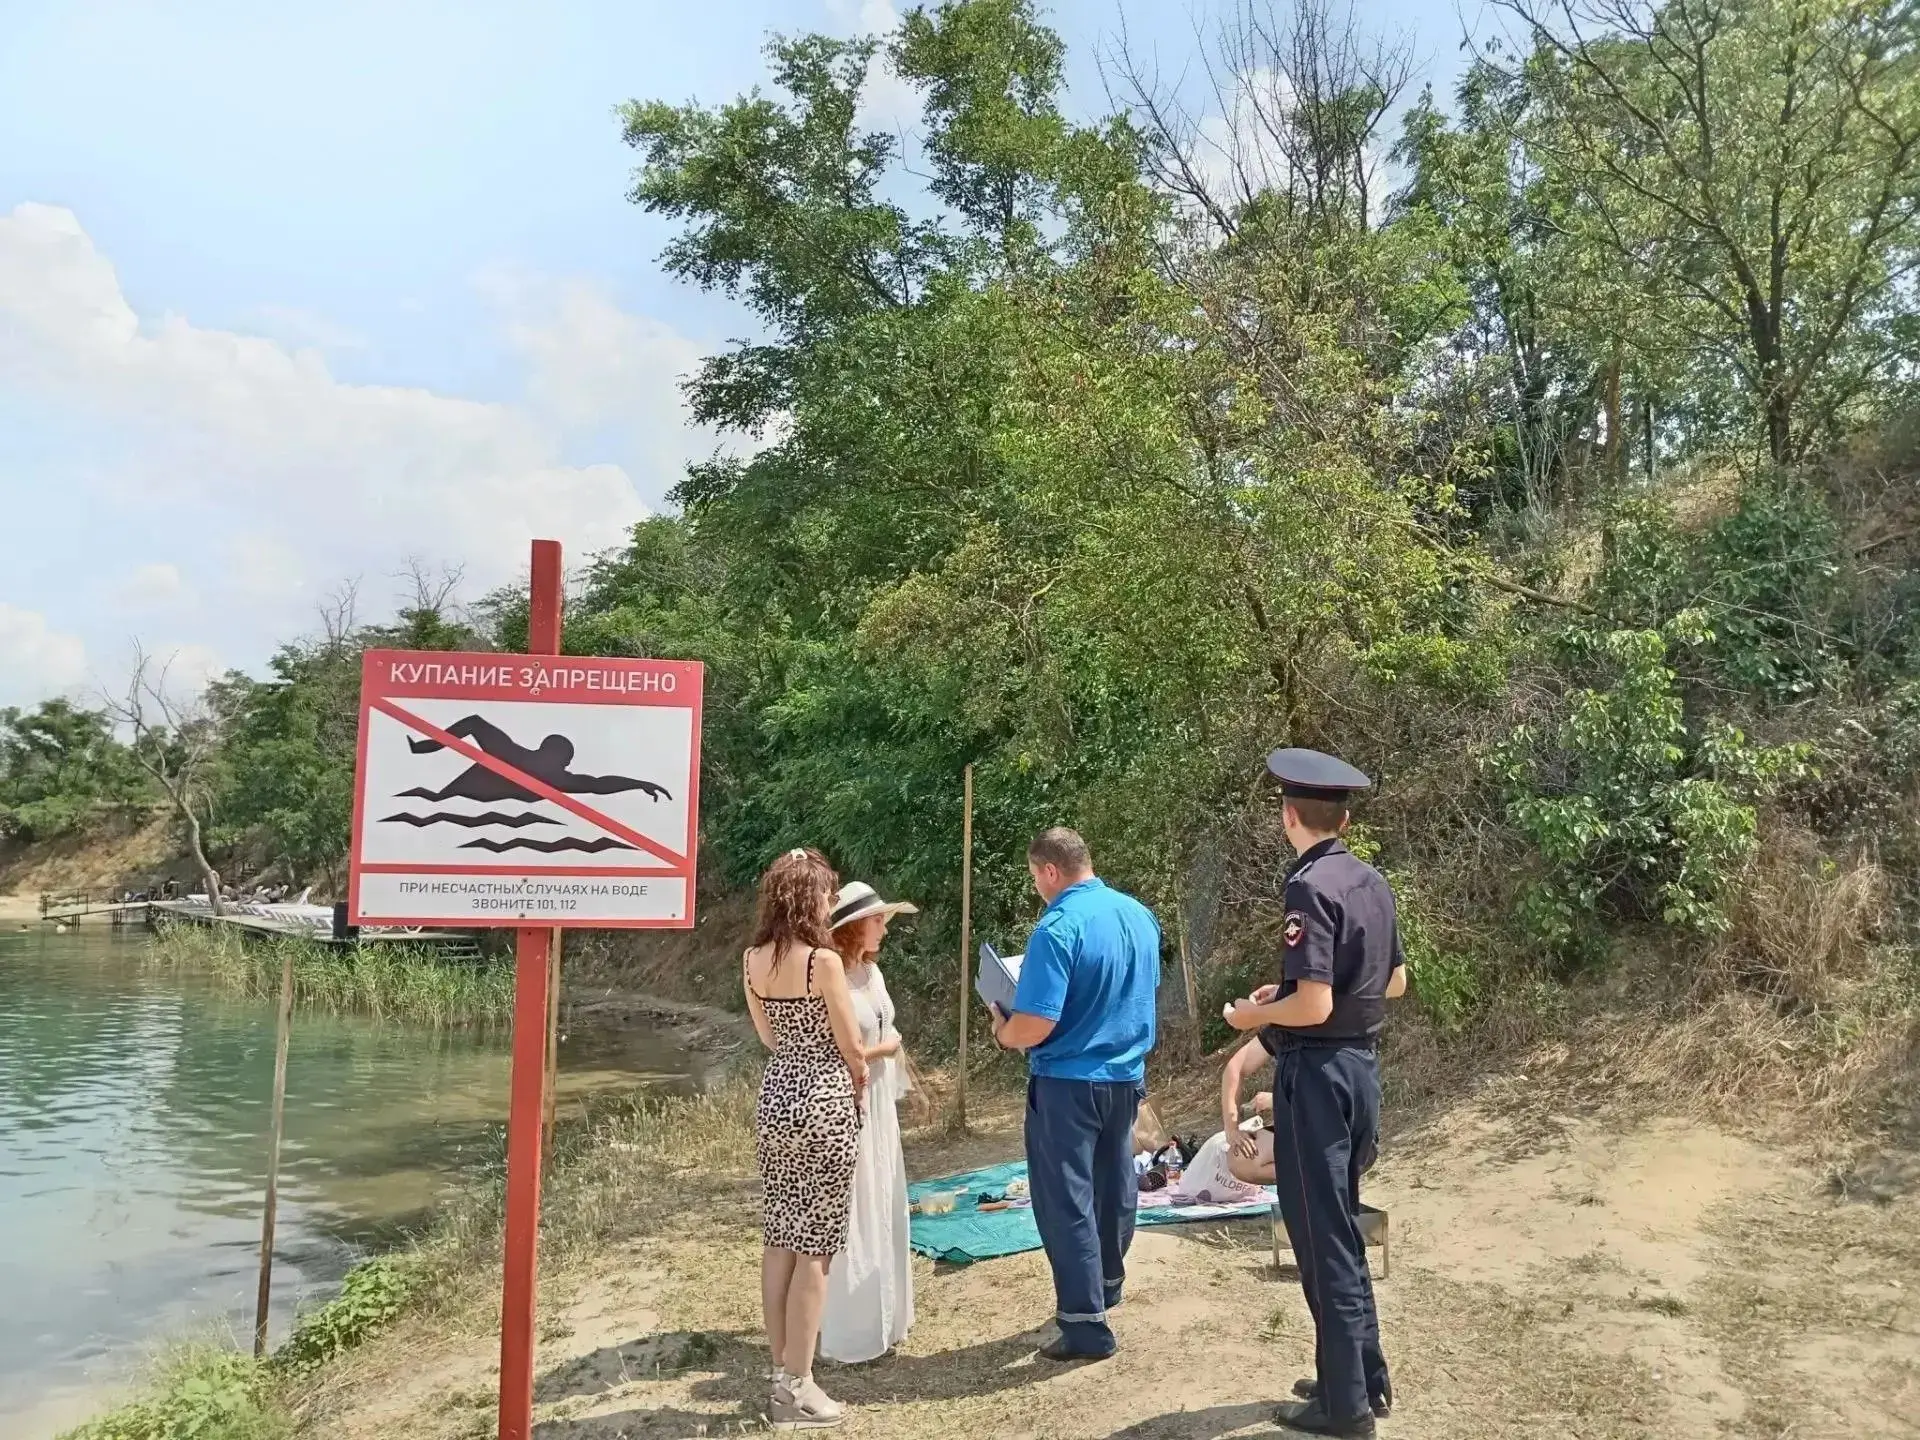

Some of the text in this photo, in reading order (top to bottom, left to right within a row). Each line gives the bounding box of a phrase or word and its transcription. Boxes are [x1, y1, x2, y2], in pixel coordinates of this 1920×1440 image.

[390, 663, 677, 694] КУПАНИЕ ЗАПРЕЩЕНО
[399, 882, 649, 897] ПРИ НЕСЧАСТНЫХ СЛУЧАЯХ НА ВОДЕ
[472, 898, 577, 911] ЗВОНИТЕ 101, 112
